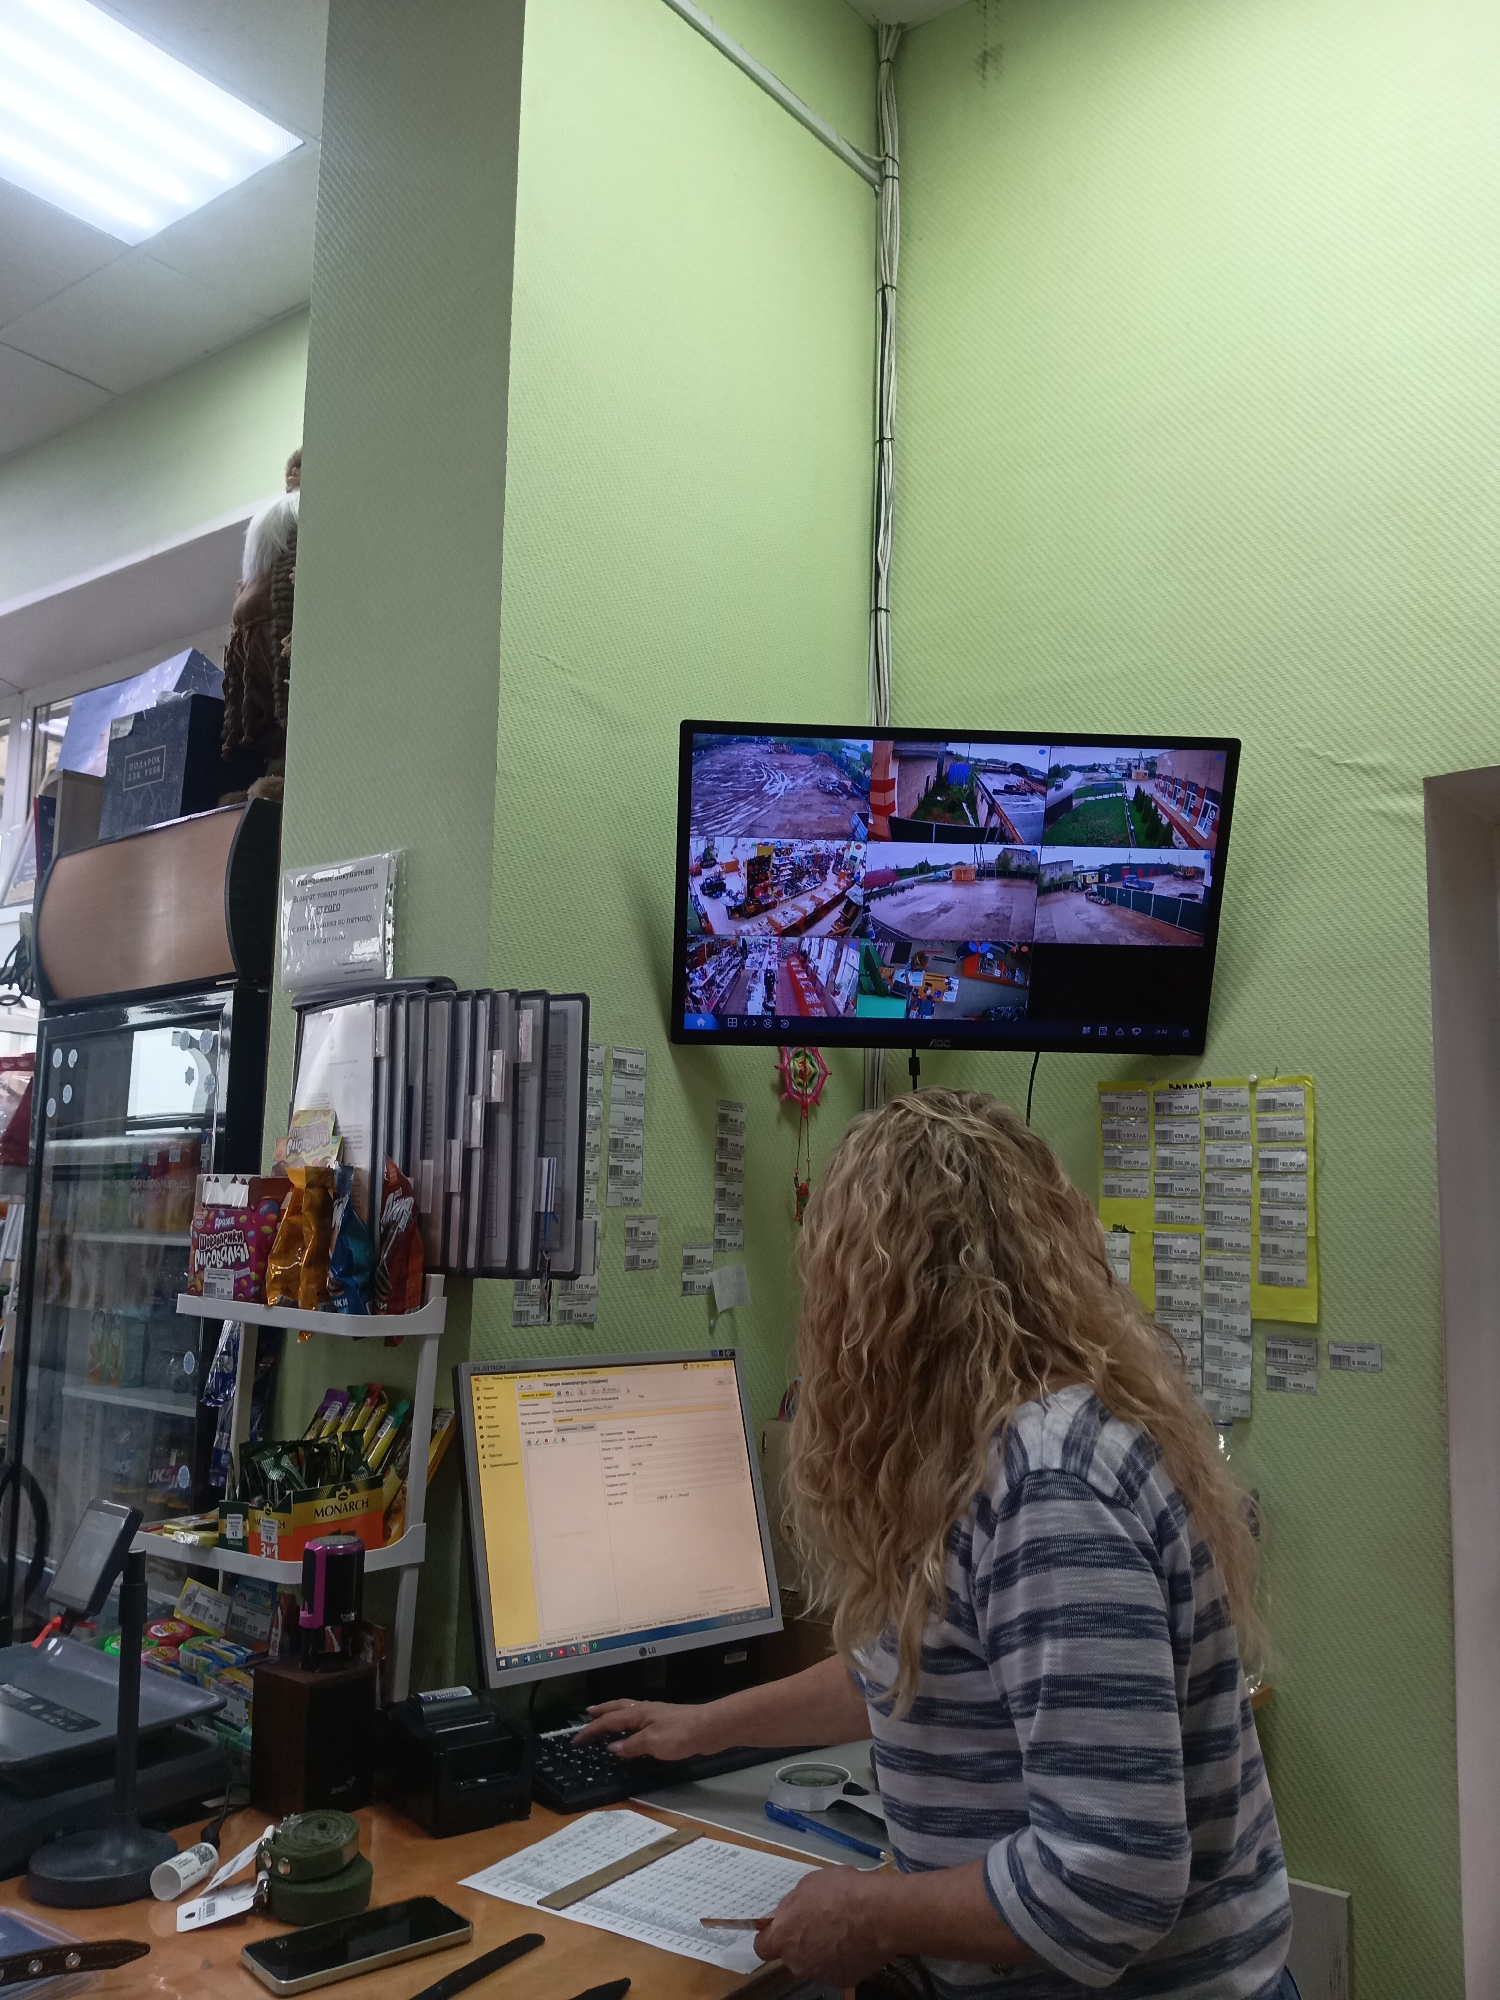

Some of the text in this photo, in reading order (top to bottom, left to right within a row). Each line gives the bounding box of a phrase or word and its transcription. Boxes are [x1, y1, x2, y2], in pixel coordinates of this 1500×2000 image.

[316, 903, 341, 914] СТРОГО
[214, 1216, 236, 1230] ДРАЖЕ
[313, 1499, 369, 1518] MONARCH
